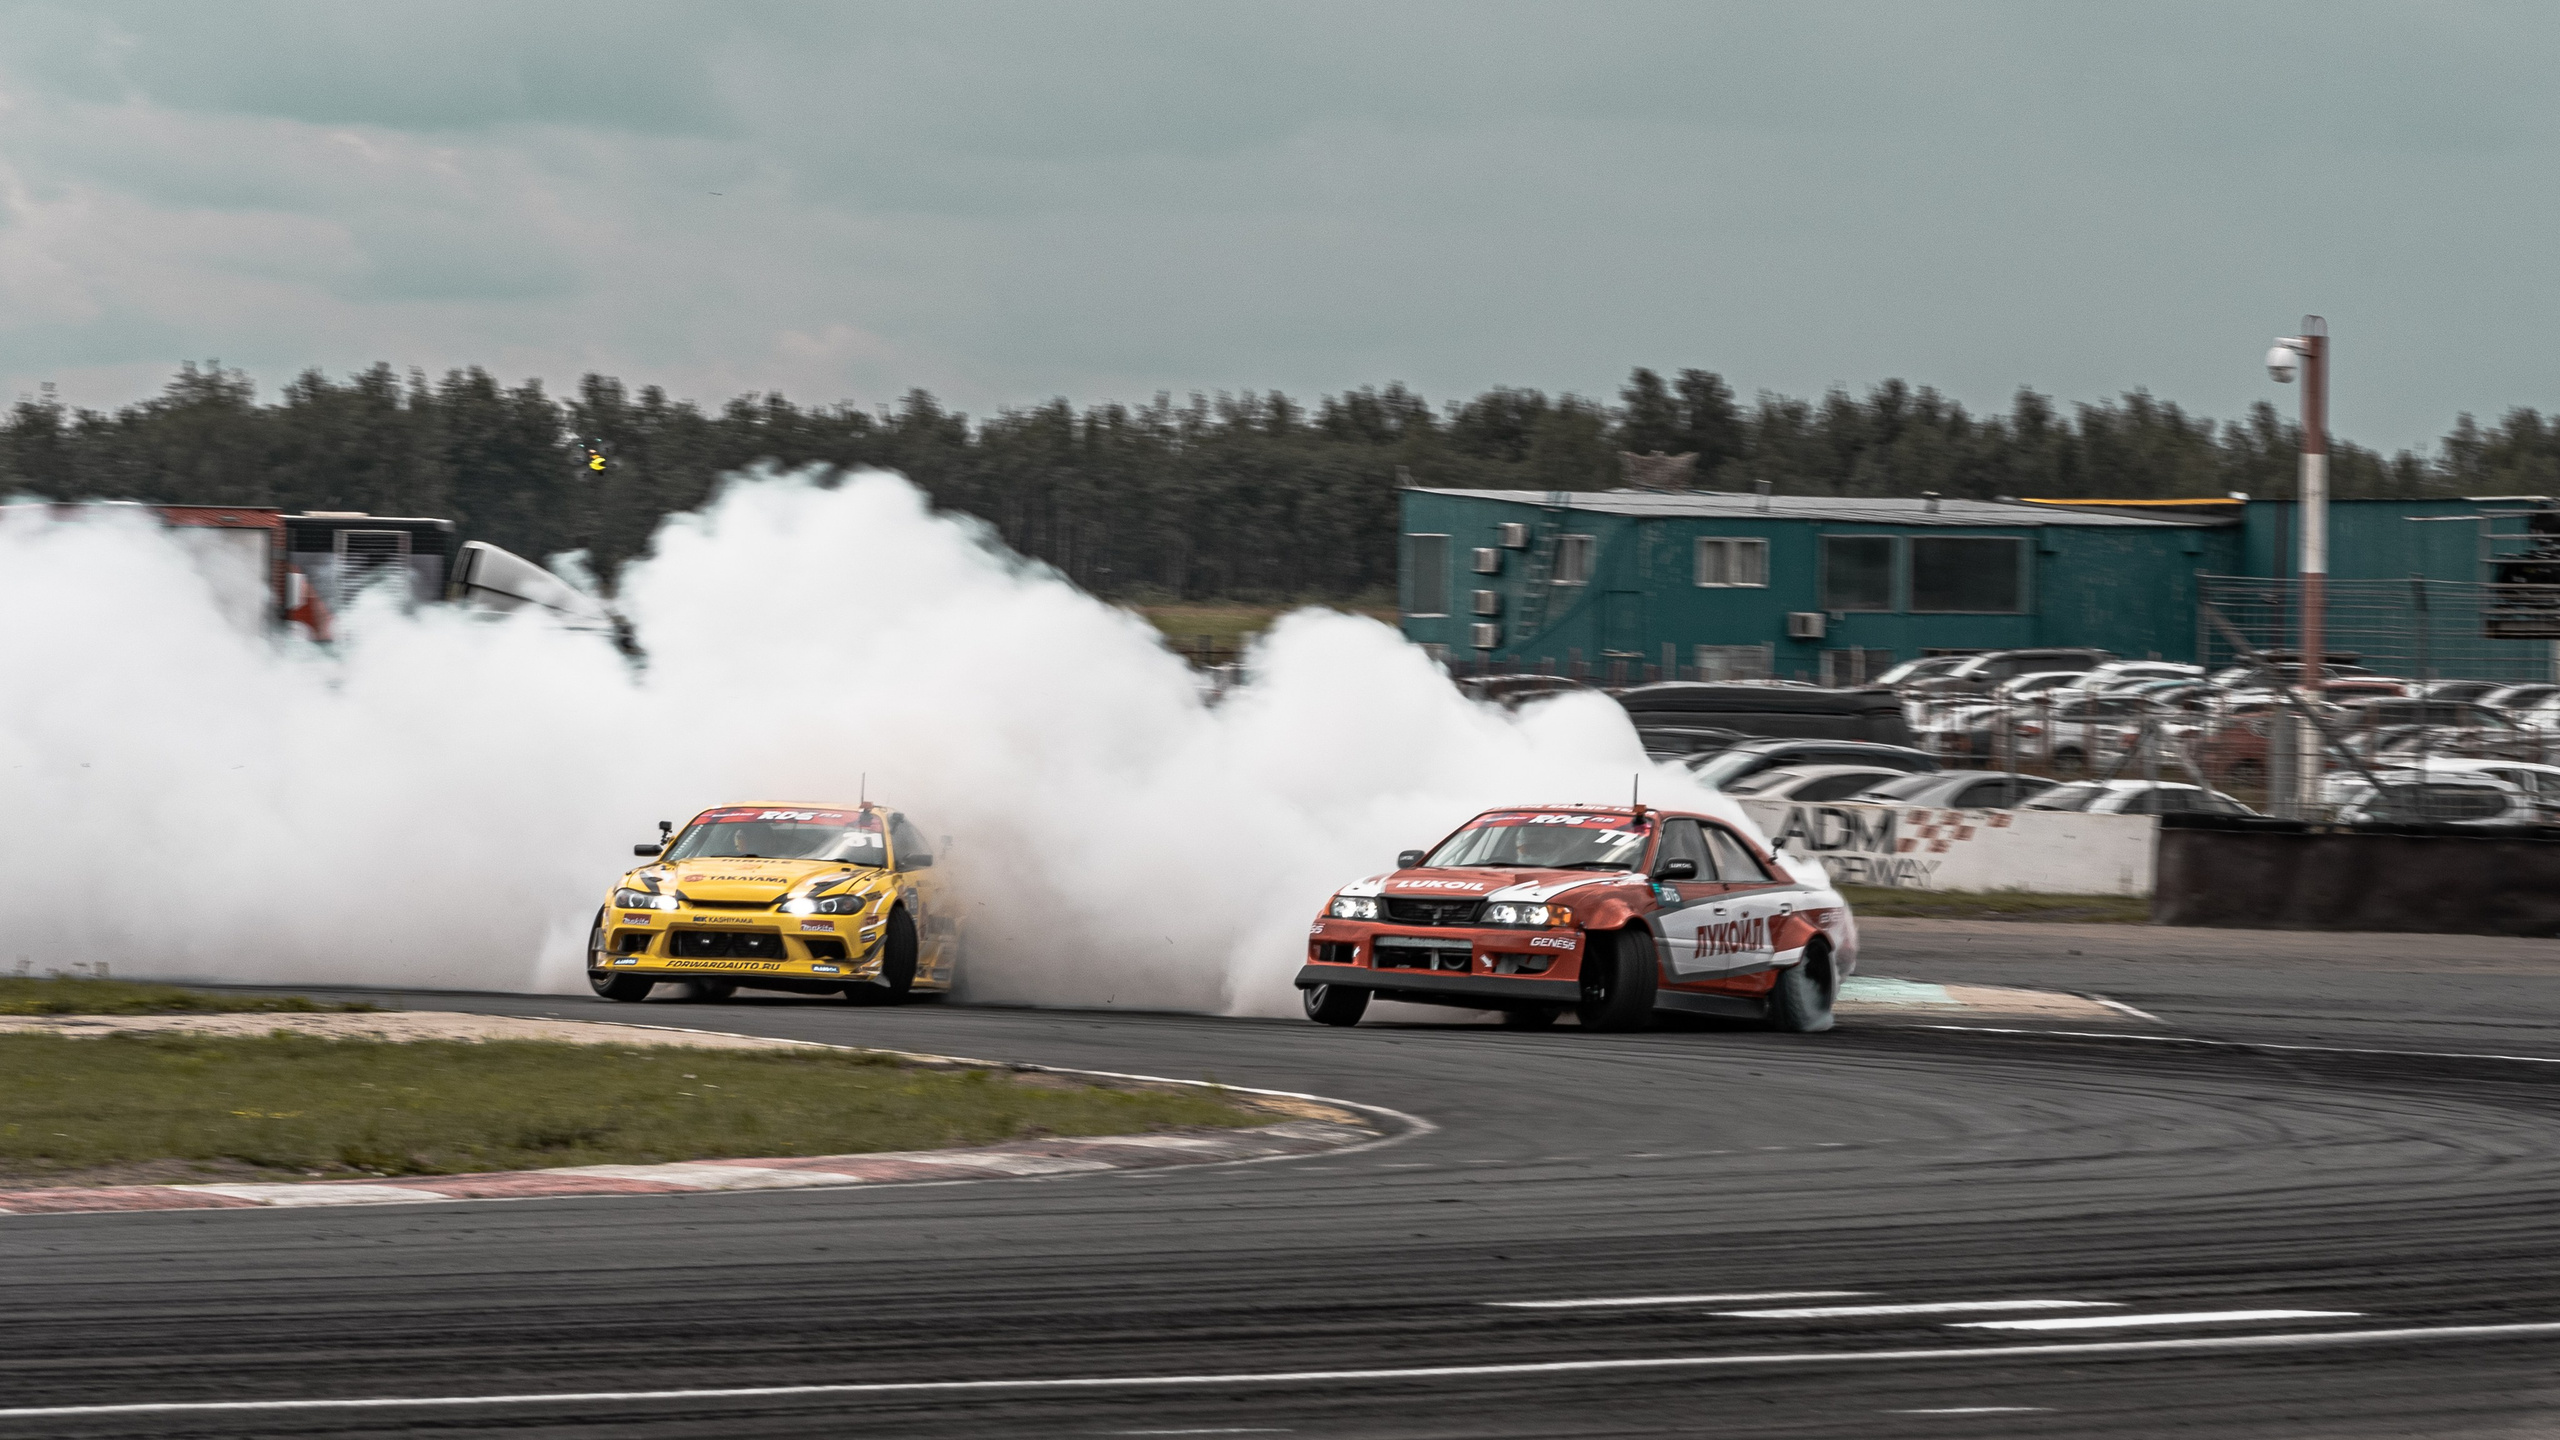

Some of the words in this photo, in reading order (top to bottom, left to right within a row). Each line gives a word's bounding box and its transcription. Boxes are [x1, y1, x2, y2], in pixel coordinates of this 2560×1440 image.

[757, 811, 817, 821] RDS
[1528, 814, 1590, 825] RDS
[1777, 806, 1897, 855] ADM
[1594, 828, 1638, 846] 77
[710, 875, 788, 884] TAKAYAMA
[1396, 880, 1486, 891] LUKOIL
[708, 916, 754, 924] KASHIYAMA
[1694, 911, 1765, 959] ЛУКОЙЛ
[1530, 937, 1576, 950] GENESIS
[666, 960, 781, 971] FORWARDAUTO.RU
